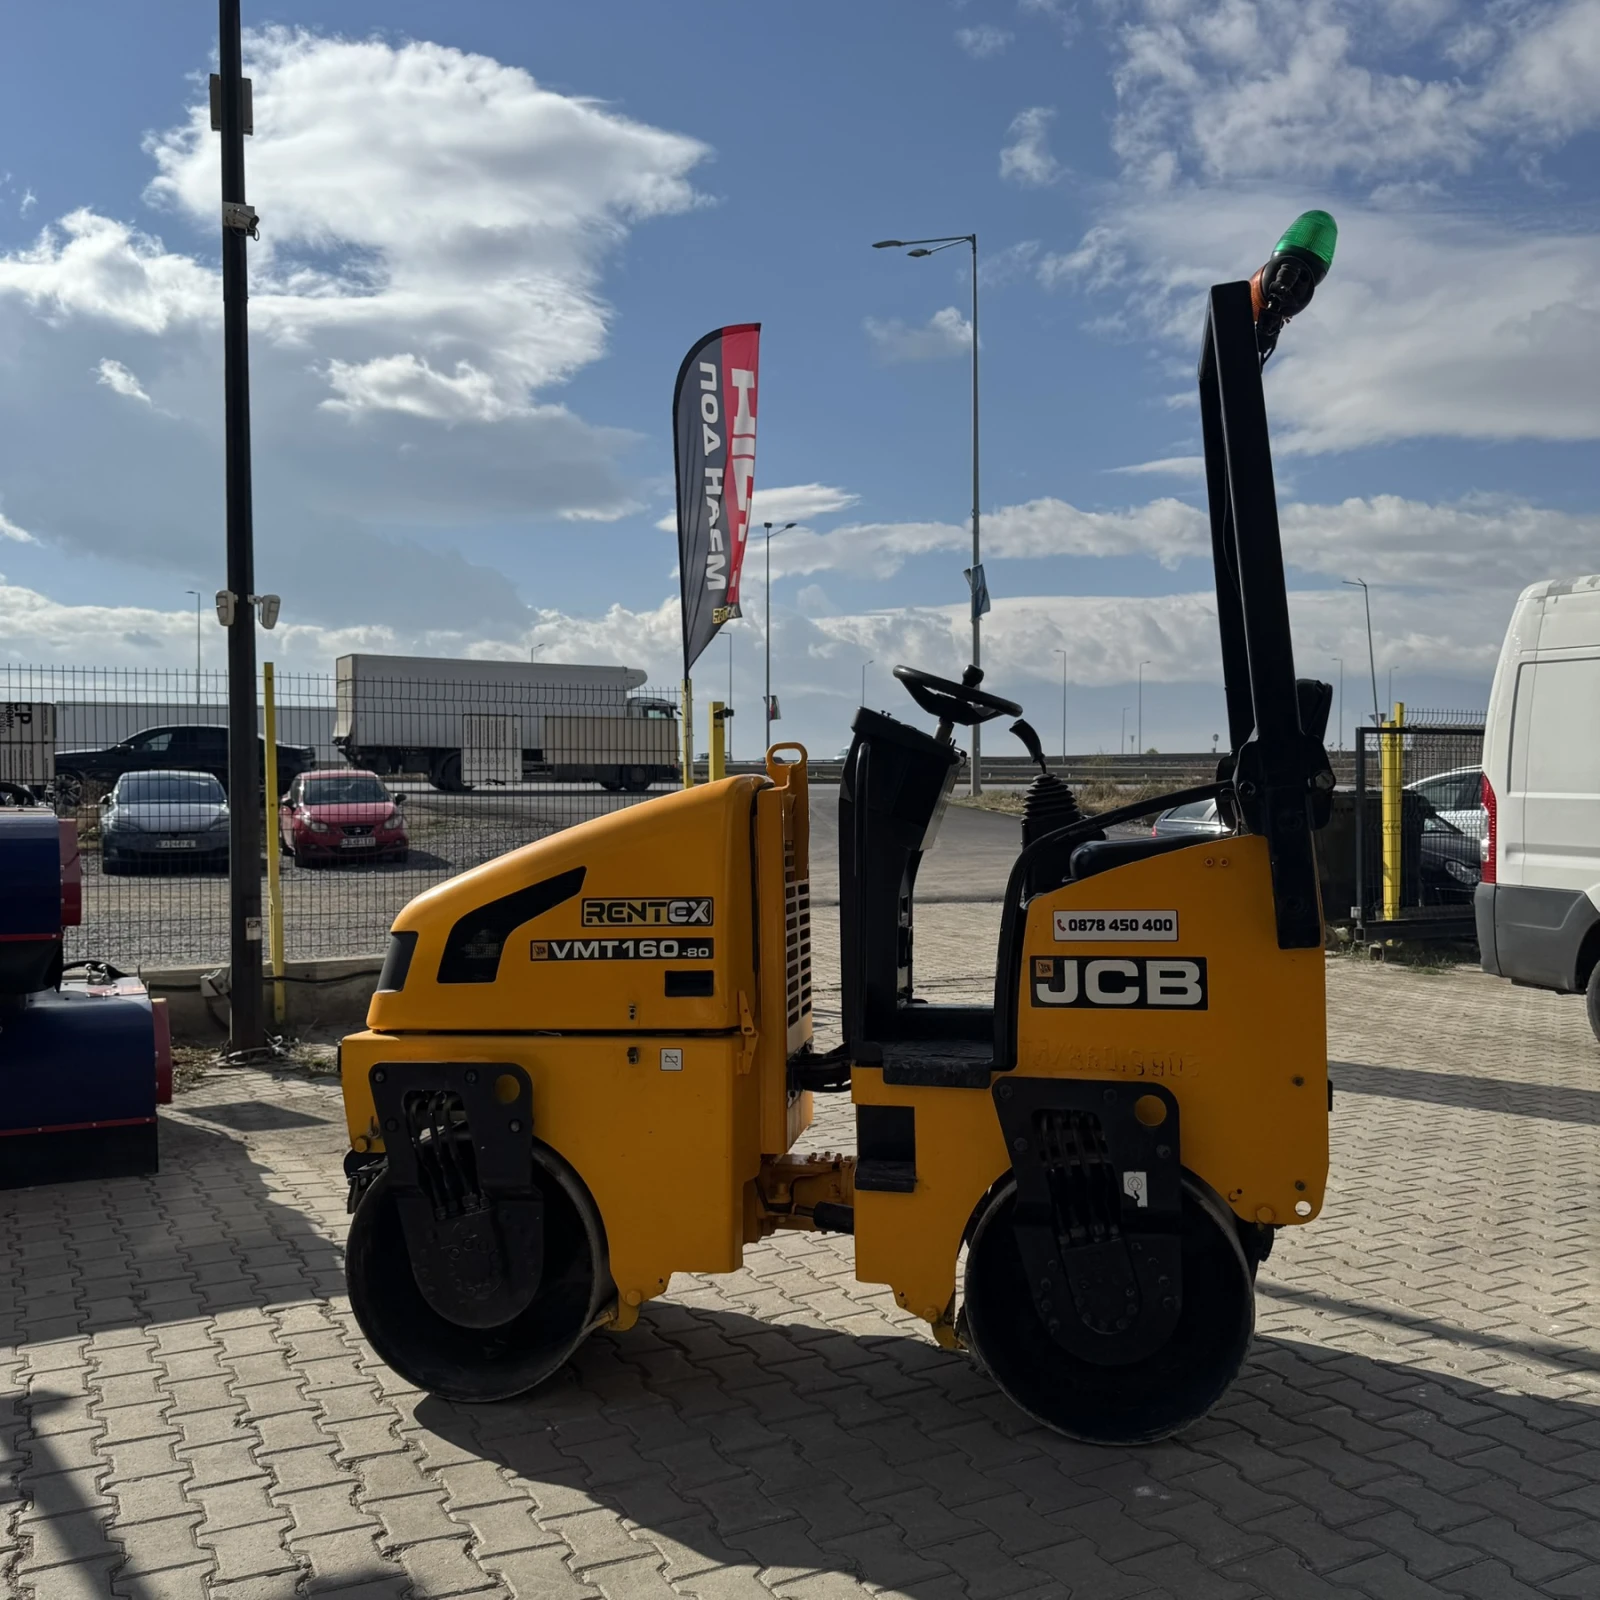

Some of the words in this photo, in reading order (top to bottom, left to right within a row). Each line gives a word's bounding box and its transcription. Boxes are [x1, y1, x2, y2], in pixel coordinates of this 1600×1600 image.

[699, 361, 721, 457] ПОД
[585, 901, 709, 923] RENTEX
[1068, 918, 1106, 932] 0878
[1108, 918, 1139, 932] 450
[1142, 918, 1173, 932] 400
[1036, 959, 1202, 1005] JCB
